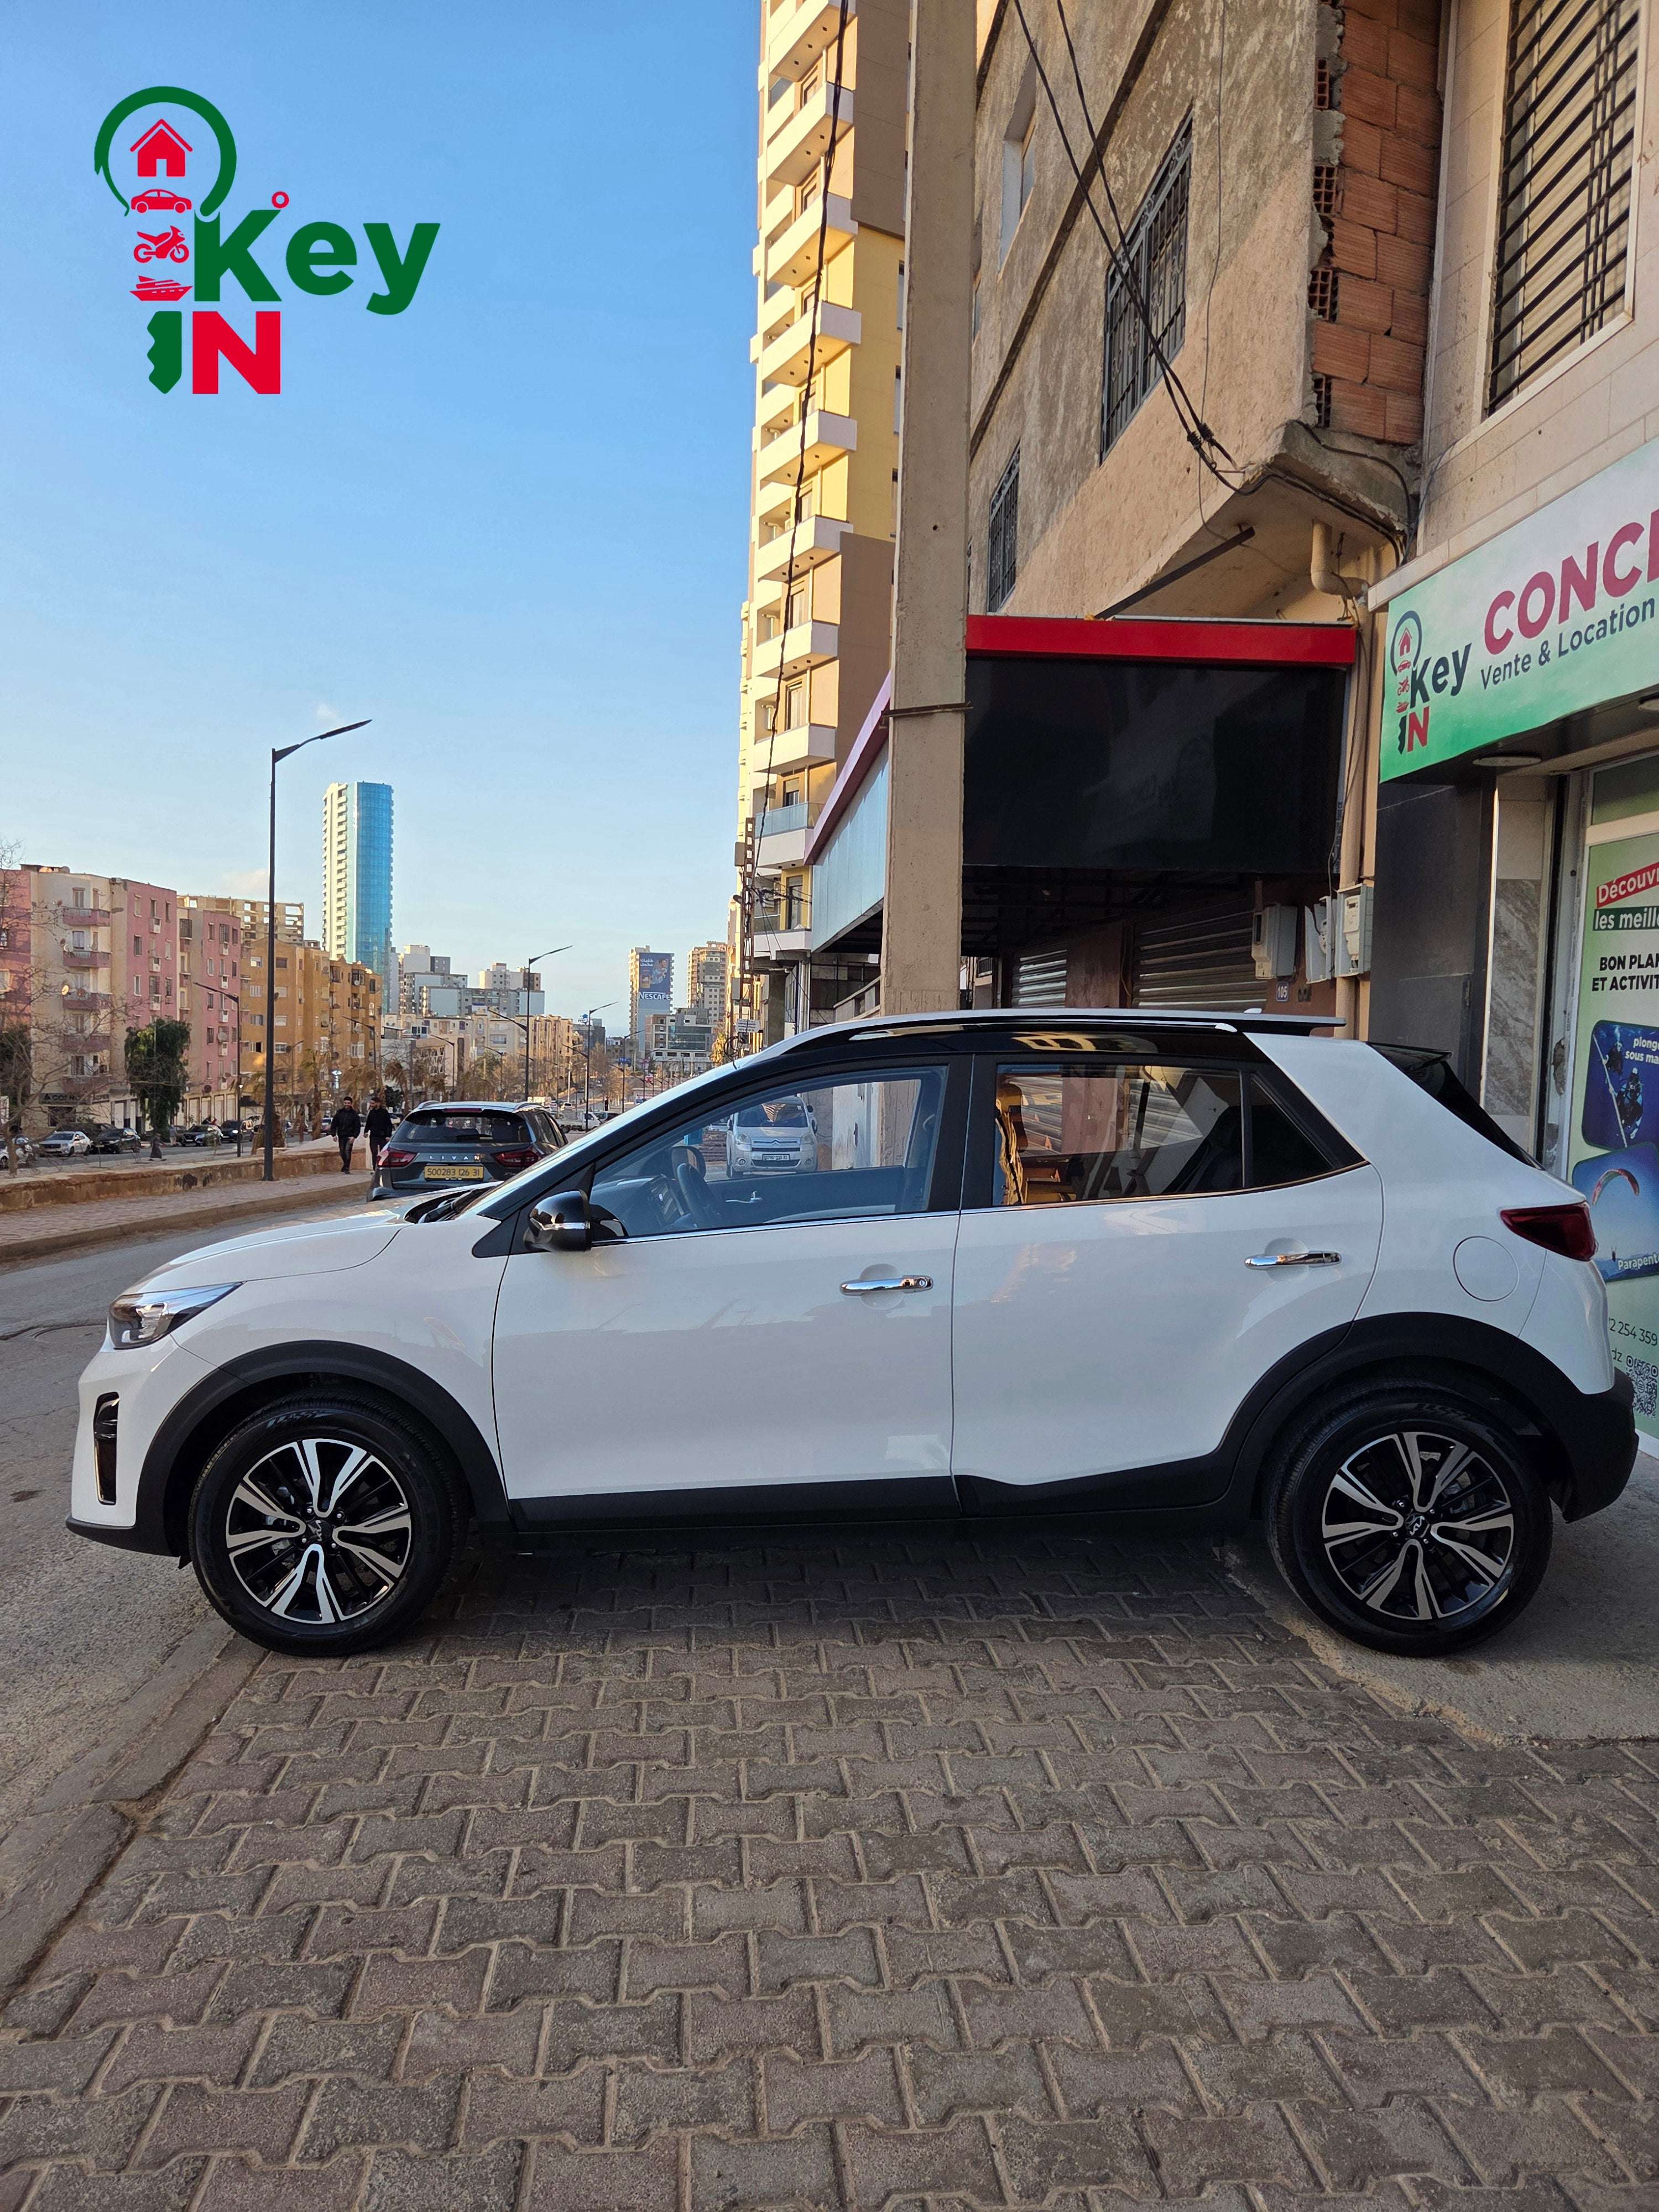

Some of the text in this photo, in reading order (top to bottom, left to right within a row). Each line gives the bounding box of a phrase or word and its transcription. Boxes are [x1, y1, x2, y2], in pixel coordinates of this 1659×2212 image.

[1480, 597, 1655, 690] Vente & Location
[1410, 643, 1472, 709] Key
[1595, 911, 1615, 930] les
[1599, 955, 1626, 971] BON
[1592, 977, 1607, 991] ET
[1625, 1051, 1644, 1061] sous
[1618, 1321, 1637, 1339] 254
[1639, 1328, 1658, 1346] 359
